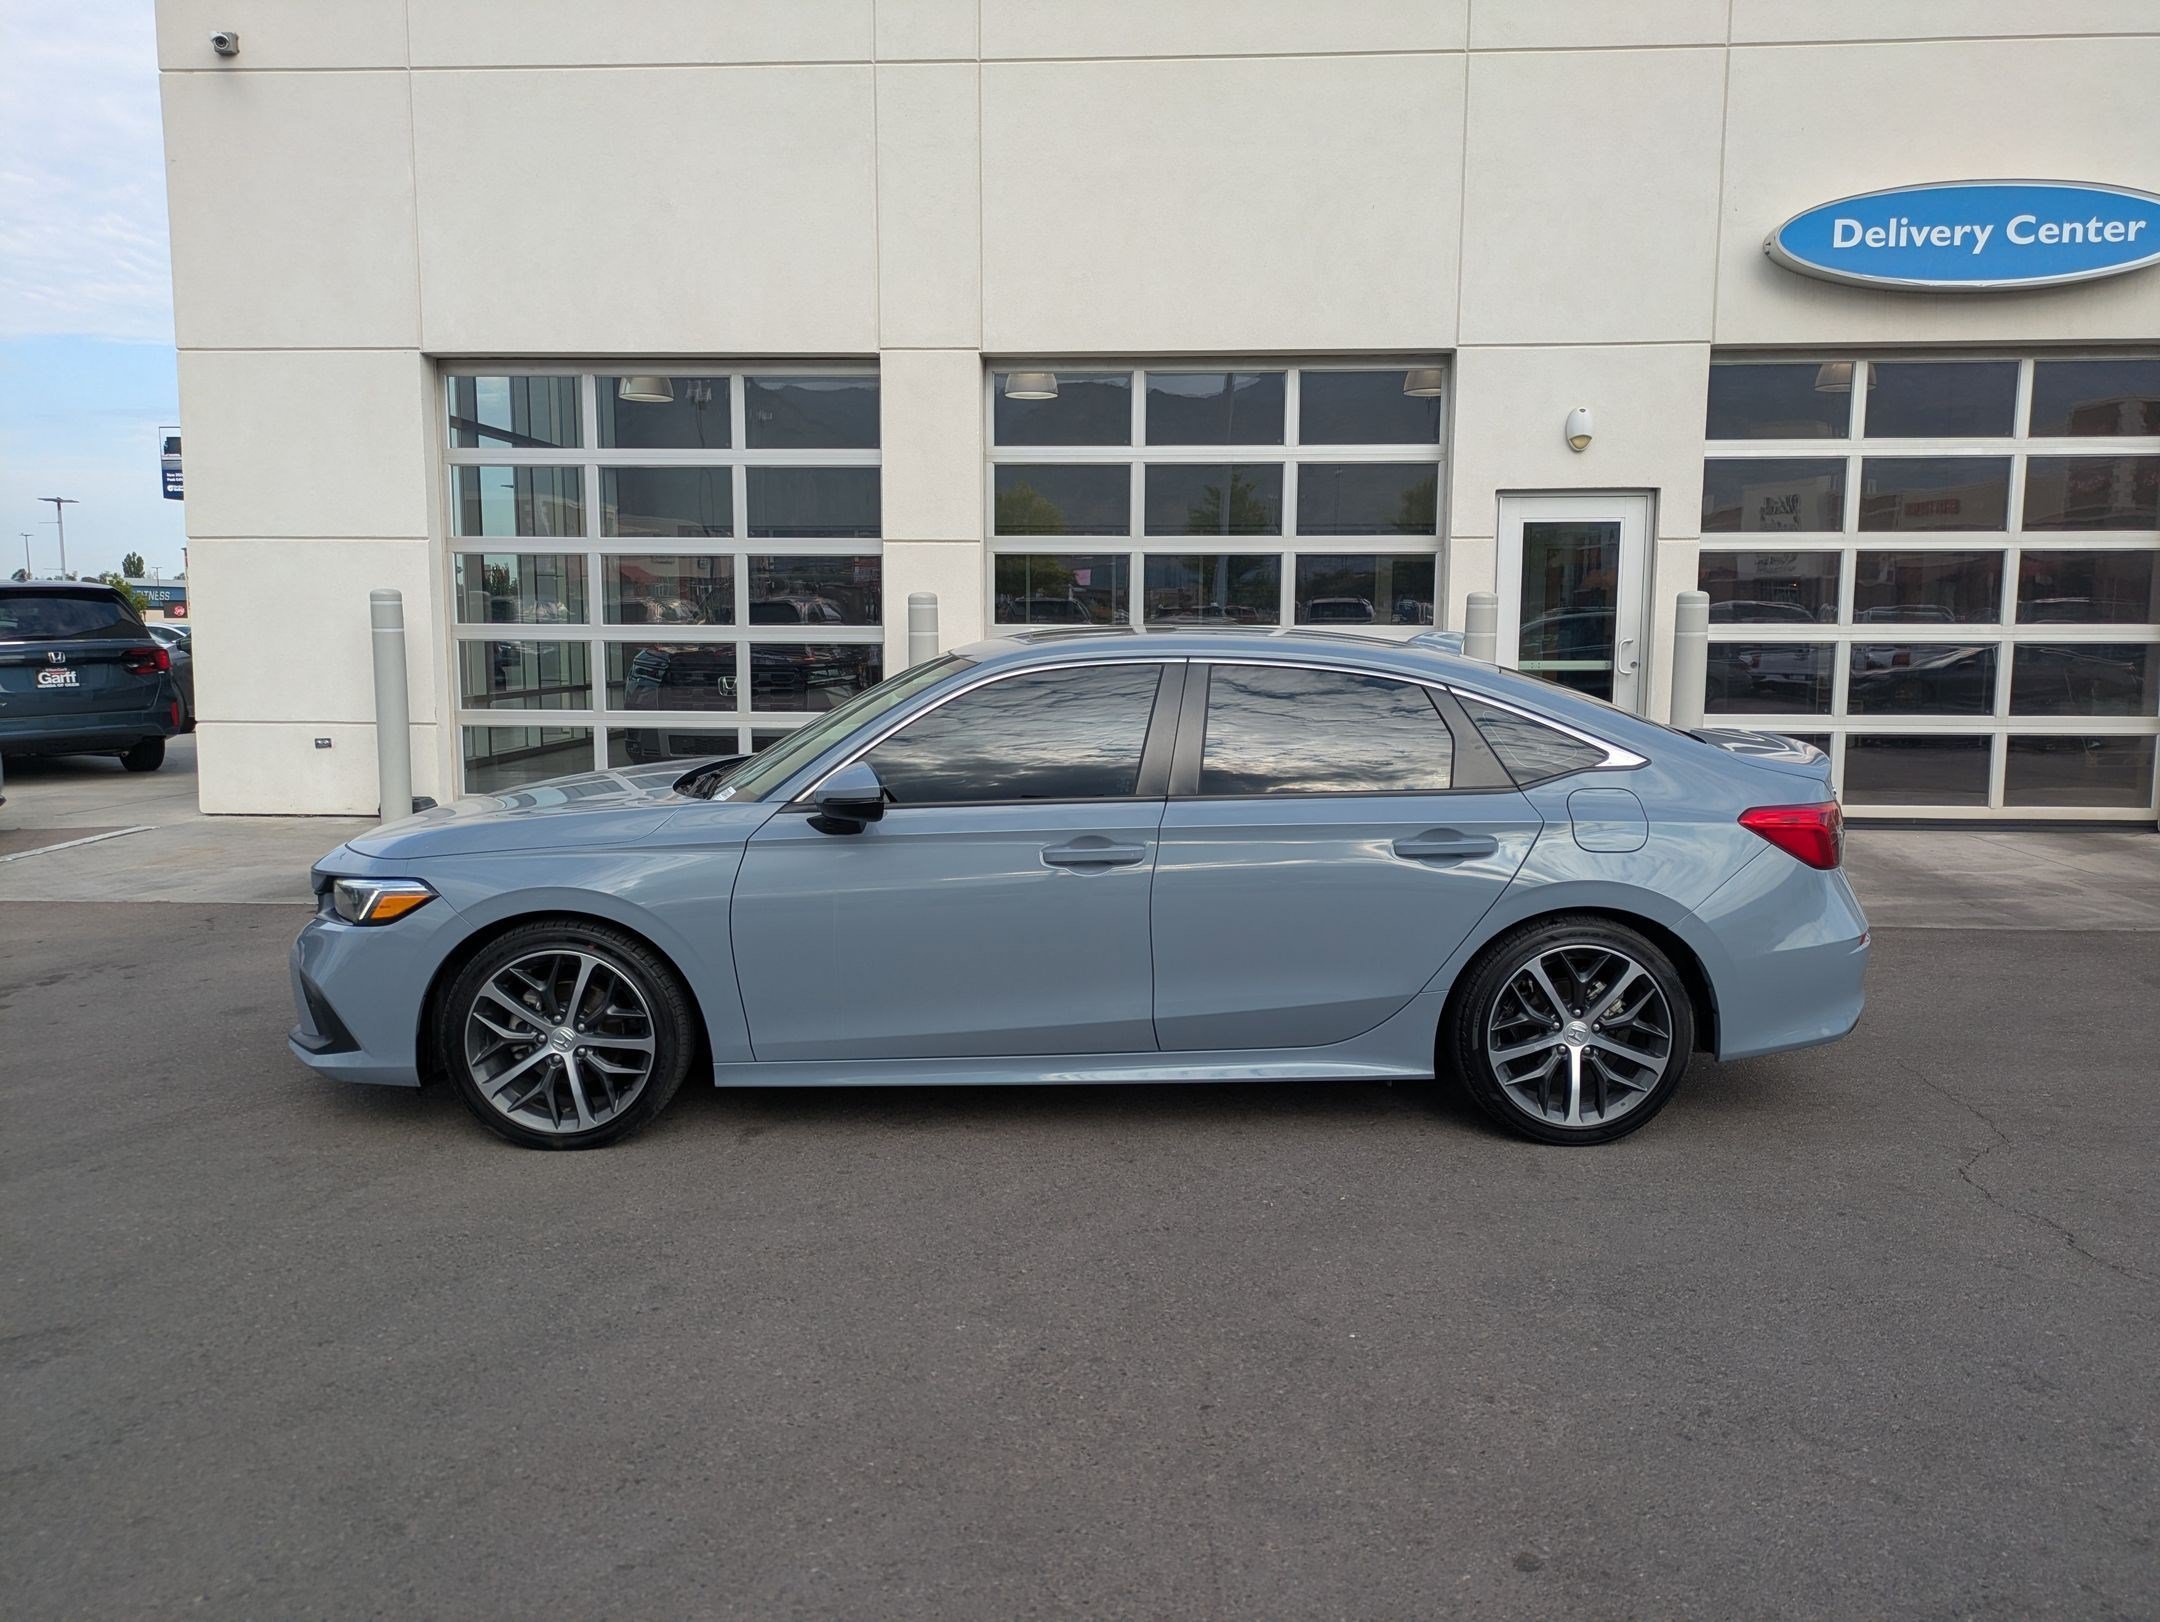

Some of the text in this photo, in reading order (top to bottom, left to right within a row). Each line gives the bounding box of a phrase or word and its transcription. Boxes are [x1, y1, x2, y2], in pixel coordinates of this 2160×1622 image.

[1833, 214, 2147, 255] Delivery Center
[136, 590, 170, 600] ITNESS
[38, 671, 77, 684] Garff
